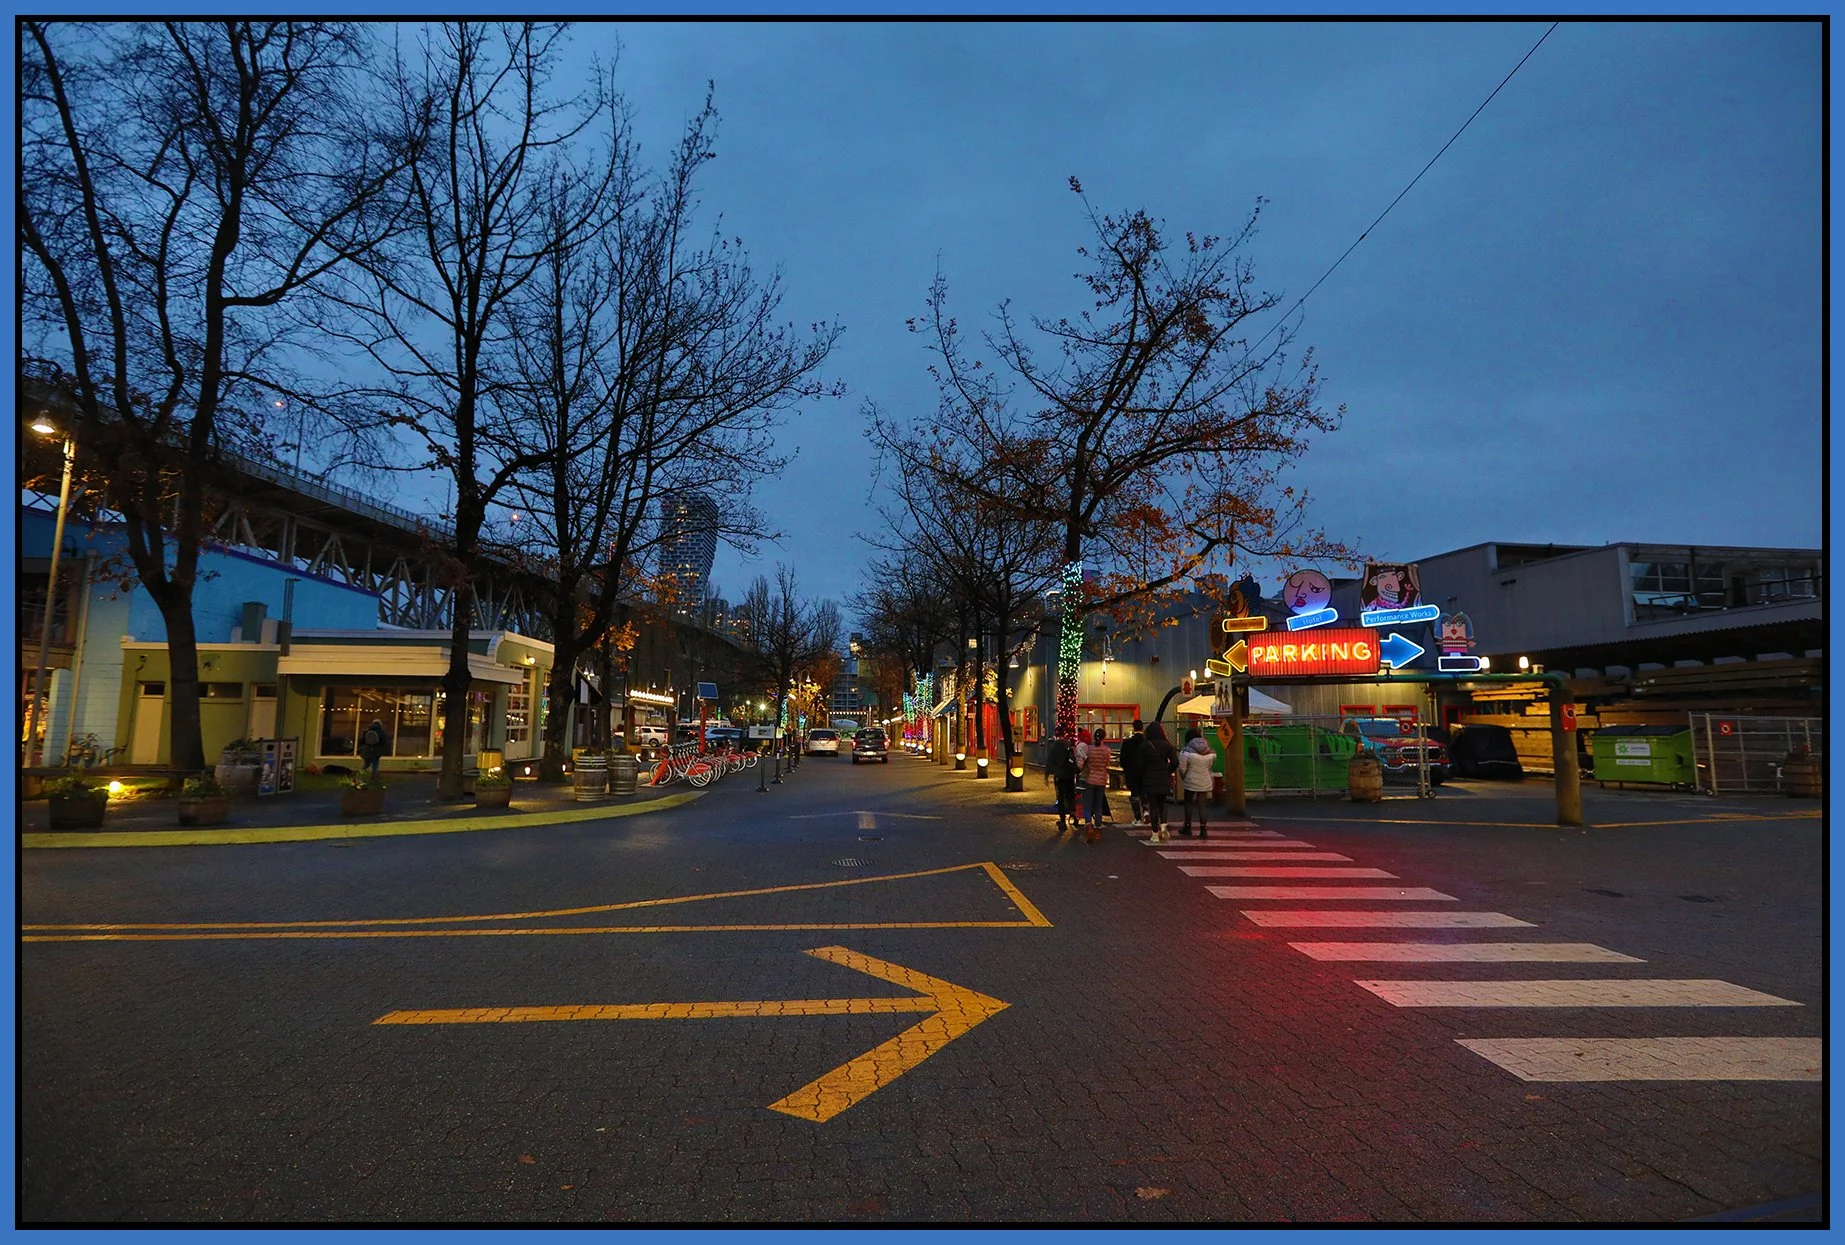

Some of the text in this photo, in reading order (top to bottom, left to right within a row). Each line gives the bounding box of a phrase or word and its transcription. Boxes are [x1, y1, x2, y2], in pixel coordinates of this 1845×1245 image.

[1302, 614, 1323, 625] Hotel
[1365, 611, 1432, 622] Performance Works
[1252, 641, 1372, 665] PARKING
